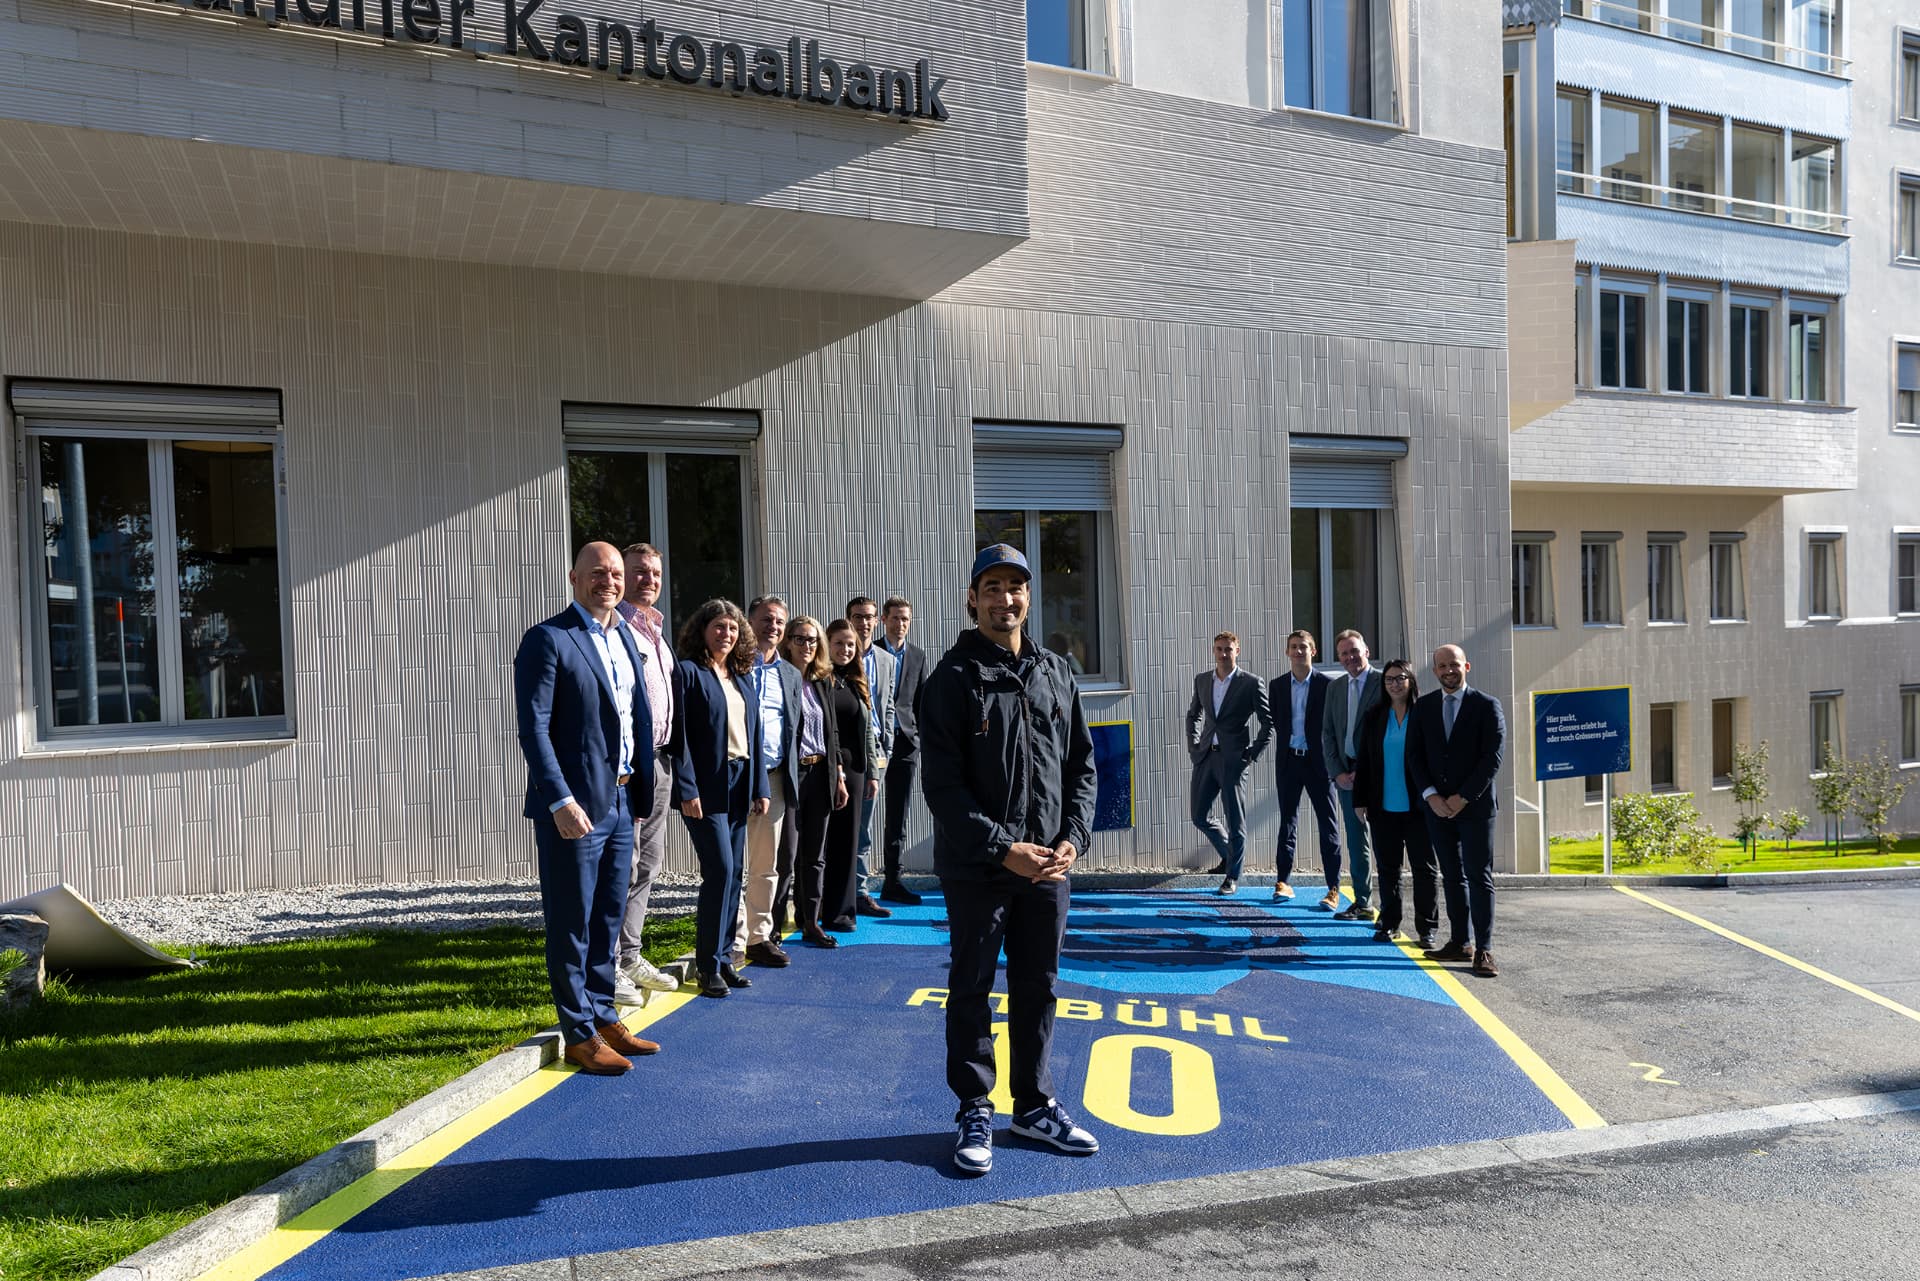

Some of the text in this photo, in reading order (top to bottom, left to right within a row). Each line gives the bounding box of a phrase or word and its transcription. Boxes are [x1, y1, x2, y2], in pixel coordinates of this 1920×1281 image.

[505, 0, 950, 122] Kantonalbank
[1546, 715, 1559, 723] Hier
[1580, 722, 1597, 730] erlebt
[1546, 735, 1560, 743] oder
[1560, 733, 1575, 742] noch
